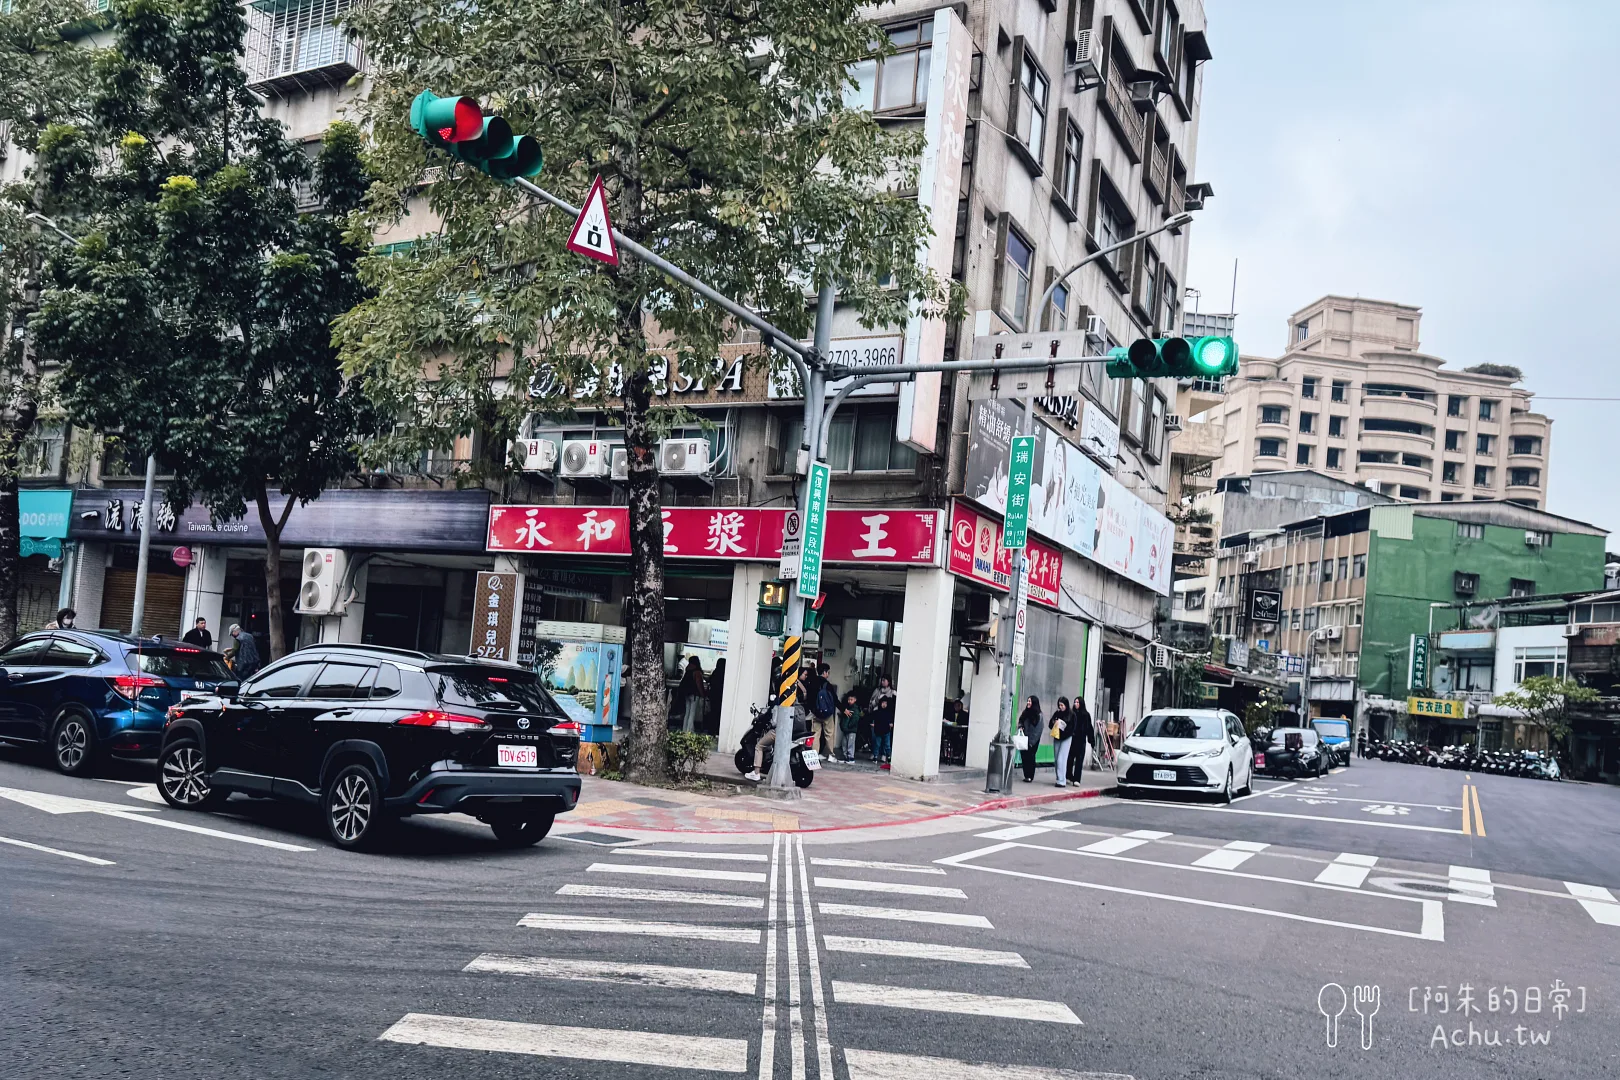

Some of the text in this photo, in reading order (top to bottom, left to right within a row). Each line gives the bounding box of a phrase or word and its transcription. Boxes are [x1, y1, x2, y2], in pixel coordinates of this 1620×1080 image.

[1011, 450, 1029, 508] 瑞安街
[808, 476, 823, 549] 復興南路二段
[187, 521, 248, 532] Taiwanee cuisine
[514, 510, 897, 559] 永和漿王
[953, 549, 971, 563] KYMCO
[763, 584, 783, 605] 21
[485, 592, 500, 645] 金琪兒
[475, 645, 505, 659] SPA
[1416, 700, 1453, 715] 布衣蔬食
